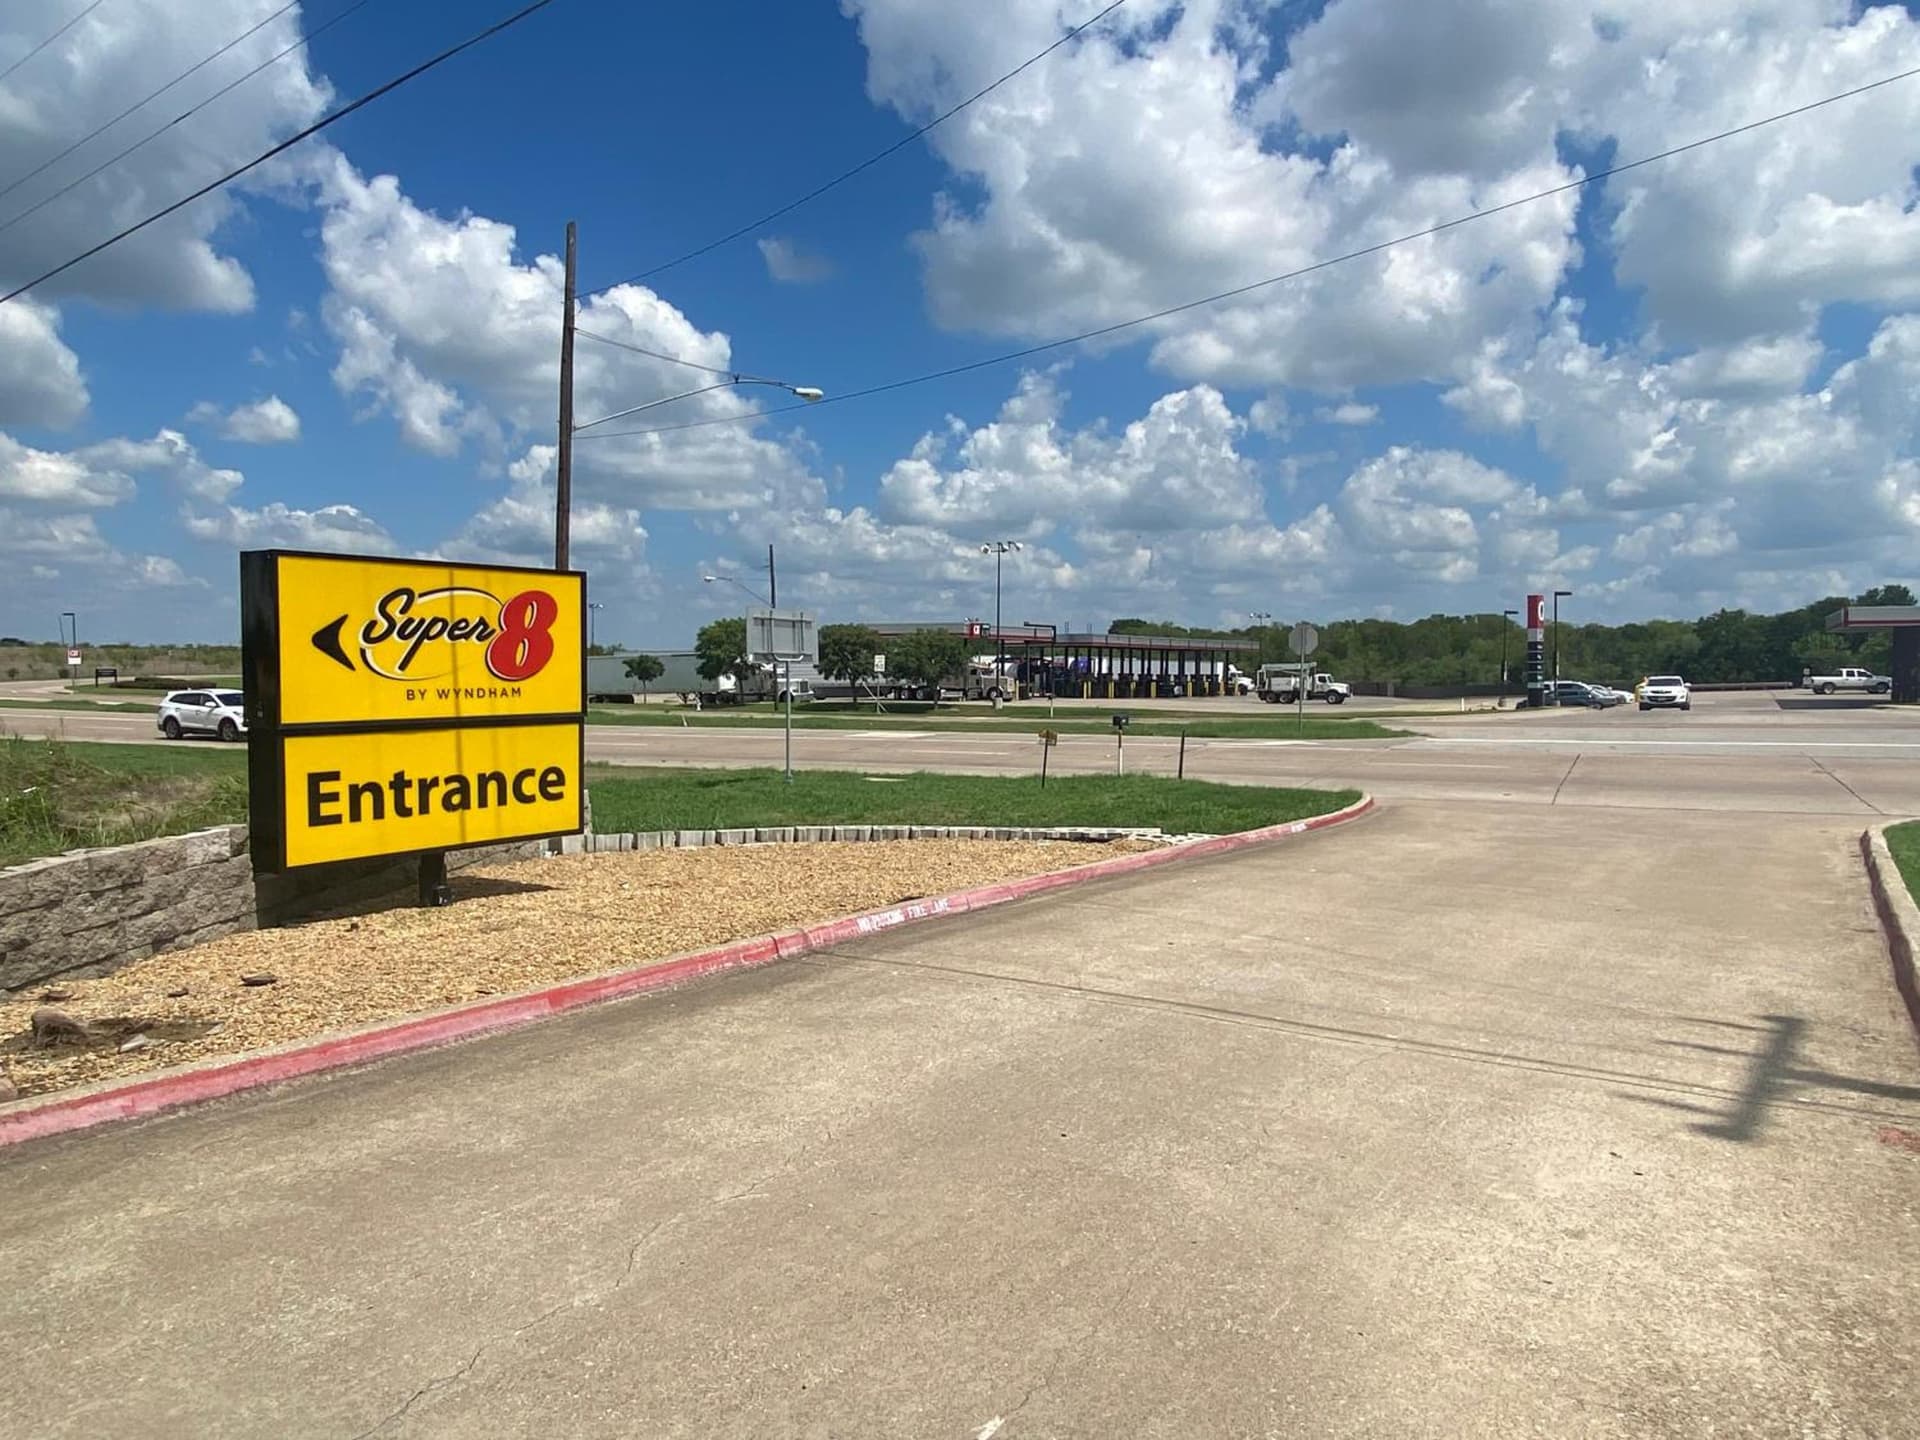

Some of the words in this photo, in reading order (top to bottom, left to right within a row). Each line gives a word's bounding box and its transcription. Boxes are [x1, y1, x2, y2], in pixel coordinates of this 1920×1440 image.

[360, 587, 498, 672] Super
[485, 590, 558, 682] 8
[406, 688, 427, 701] BY
[436, 686, 522, 700] WYNDHAM
[307, 765, 566, 828] Entrance
